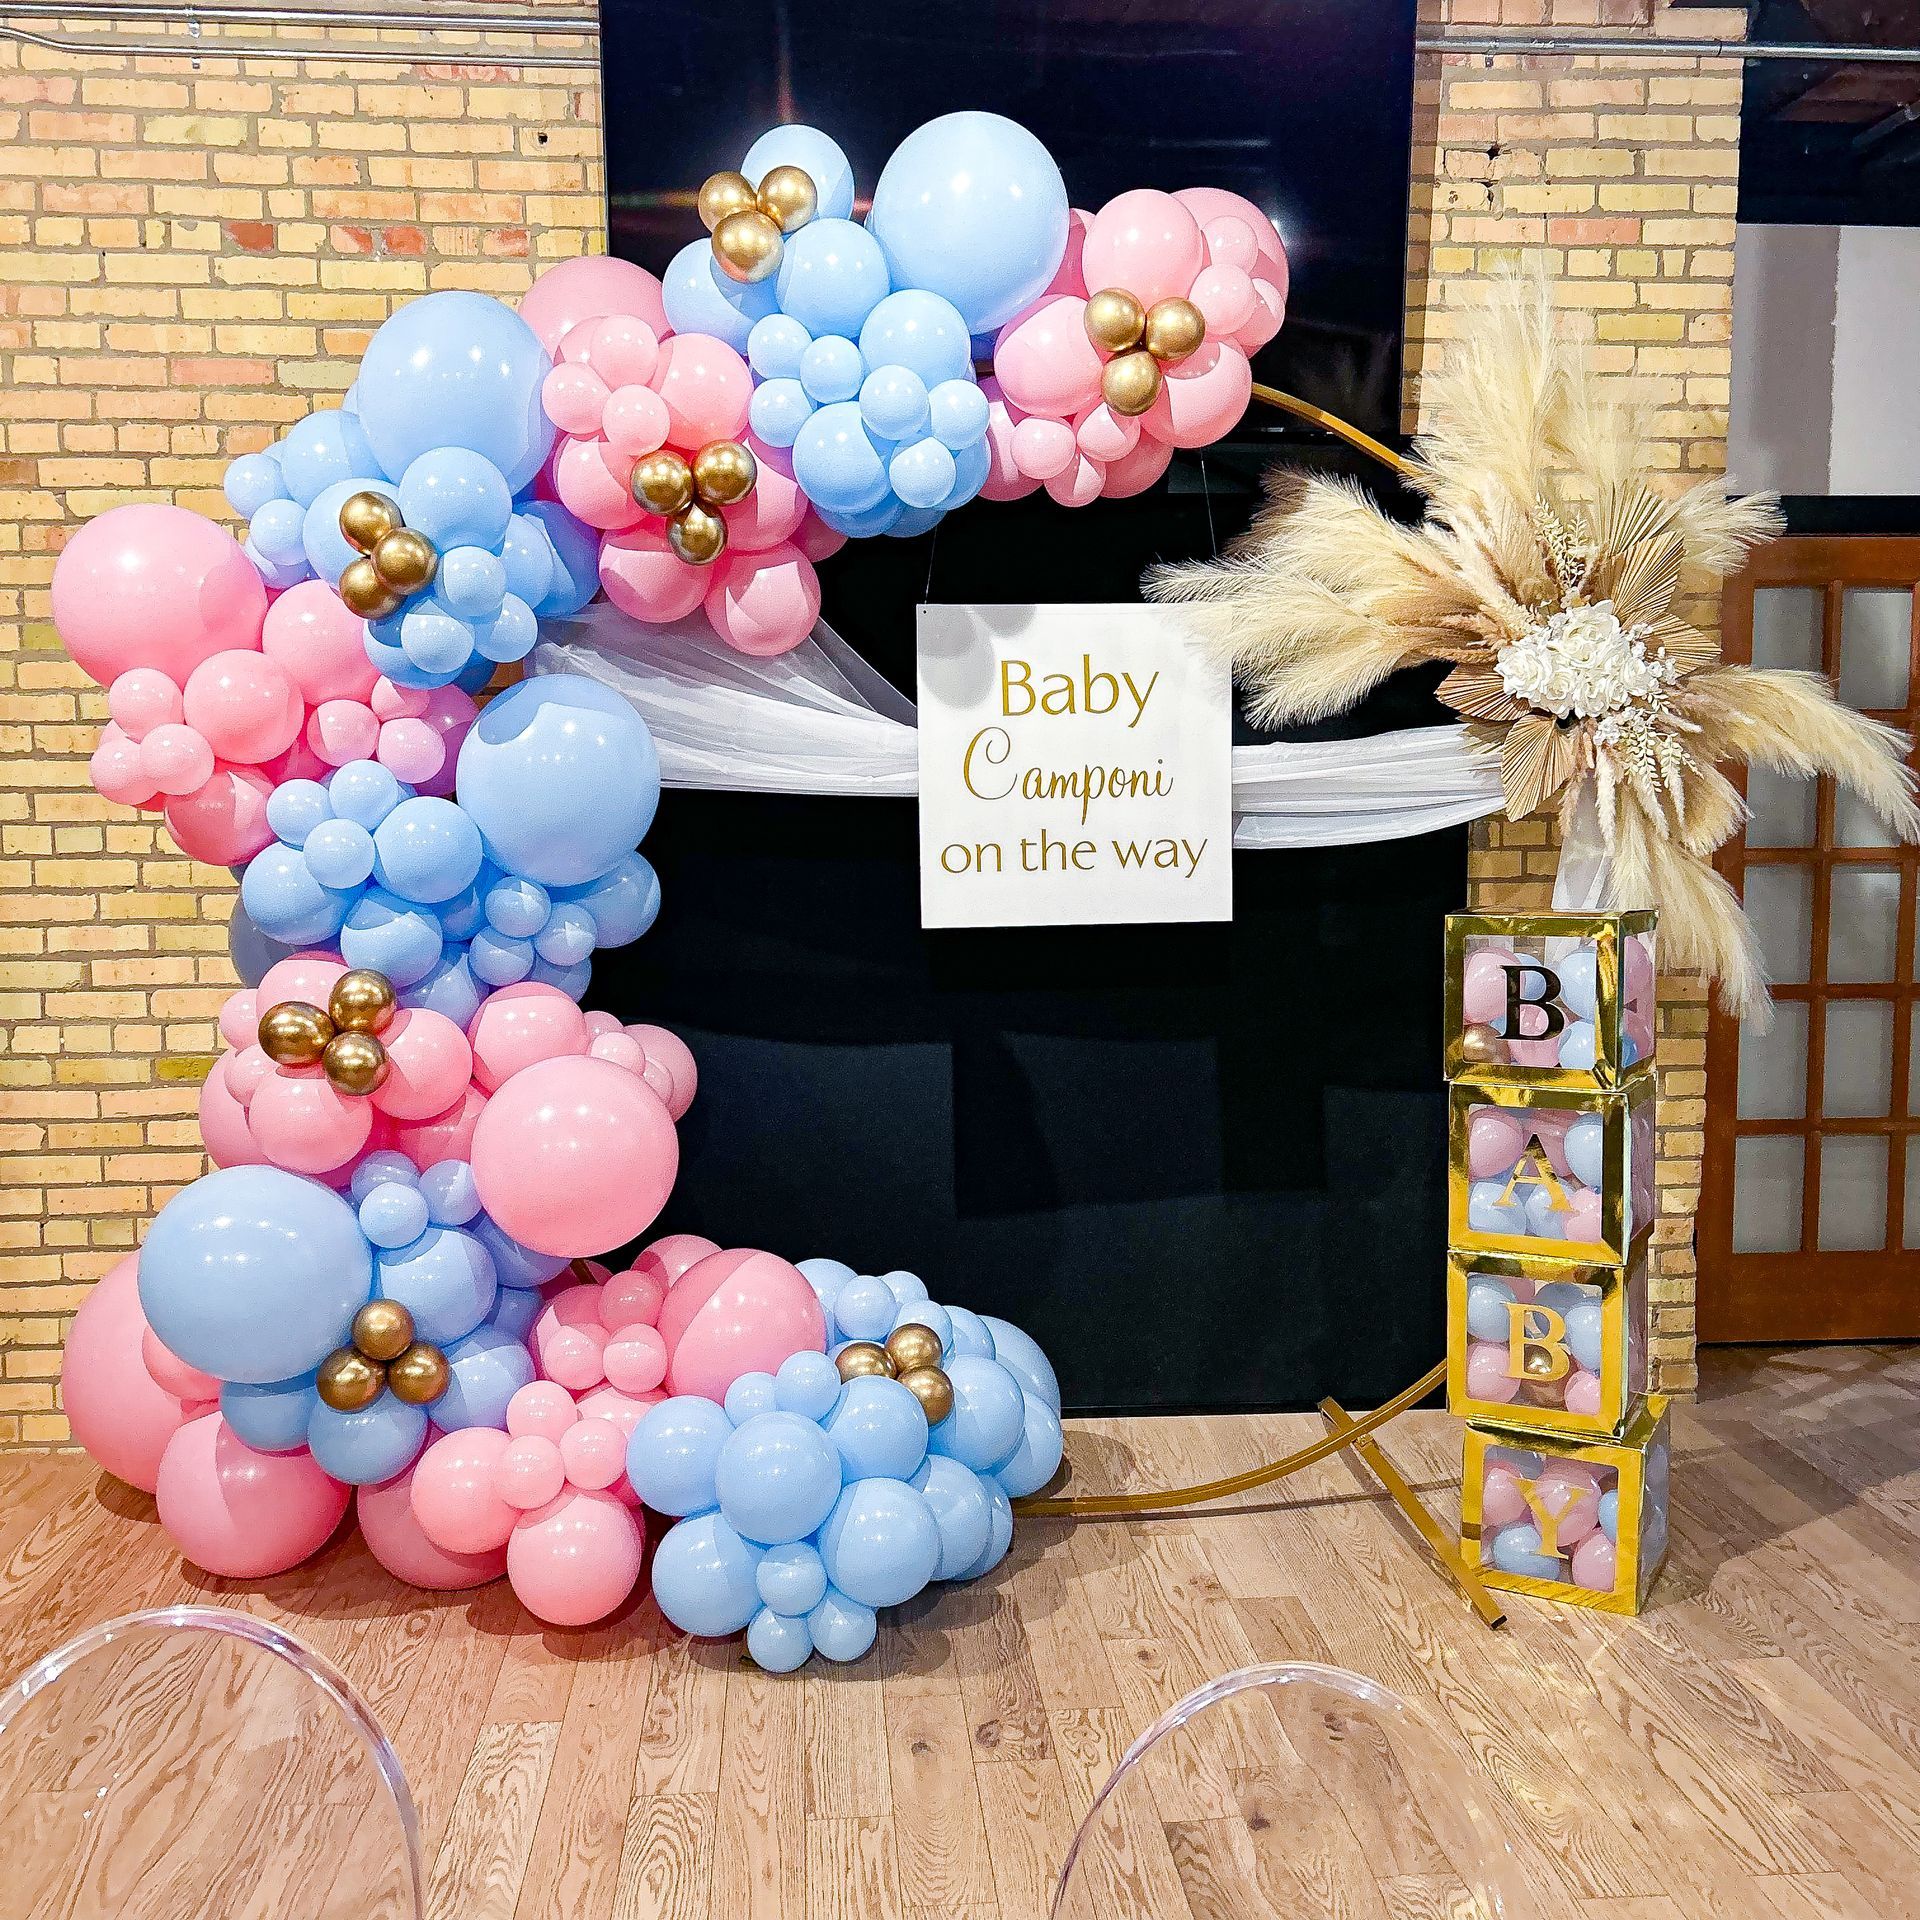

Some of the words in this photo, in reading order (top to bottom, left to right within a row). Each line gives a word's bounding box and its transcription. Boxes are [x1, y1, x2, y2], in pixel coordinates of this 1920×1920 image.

[1001, 654, 1160, 728] Baby
[963, 726, 1174, 825] Camponi
[940, 843, 1002, 874] on
[1020, 828, 1097, 871] the
[1111, 838, 1208, 879] way
